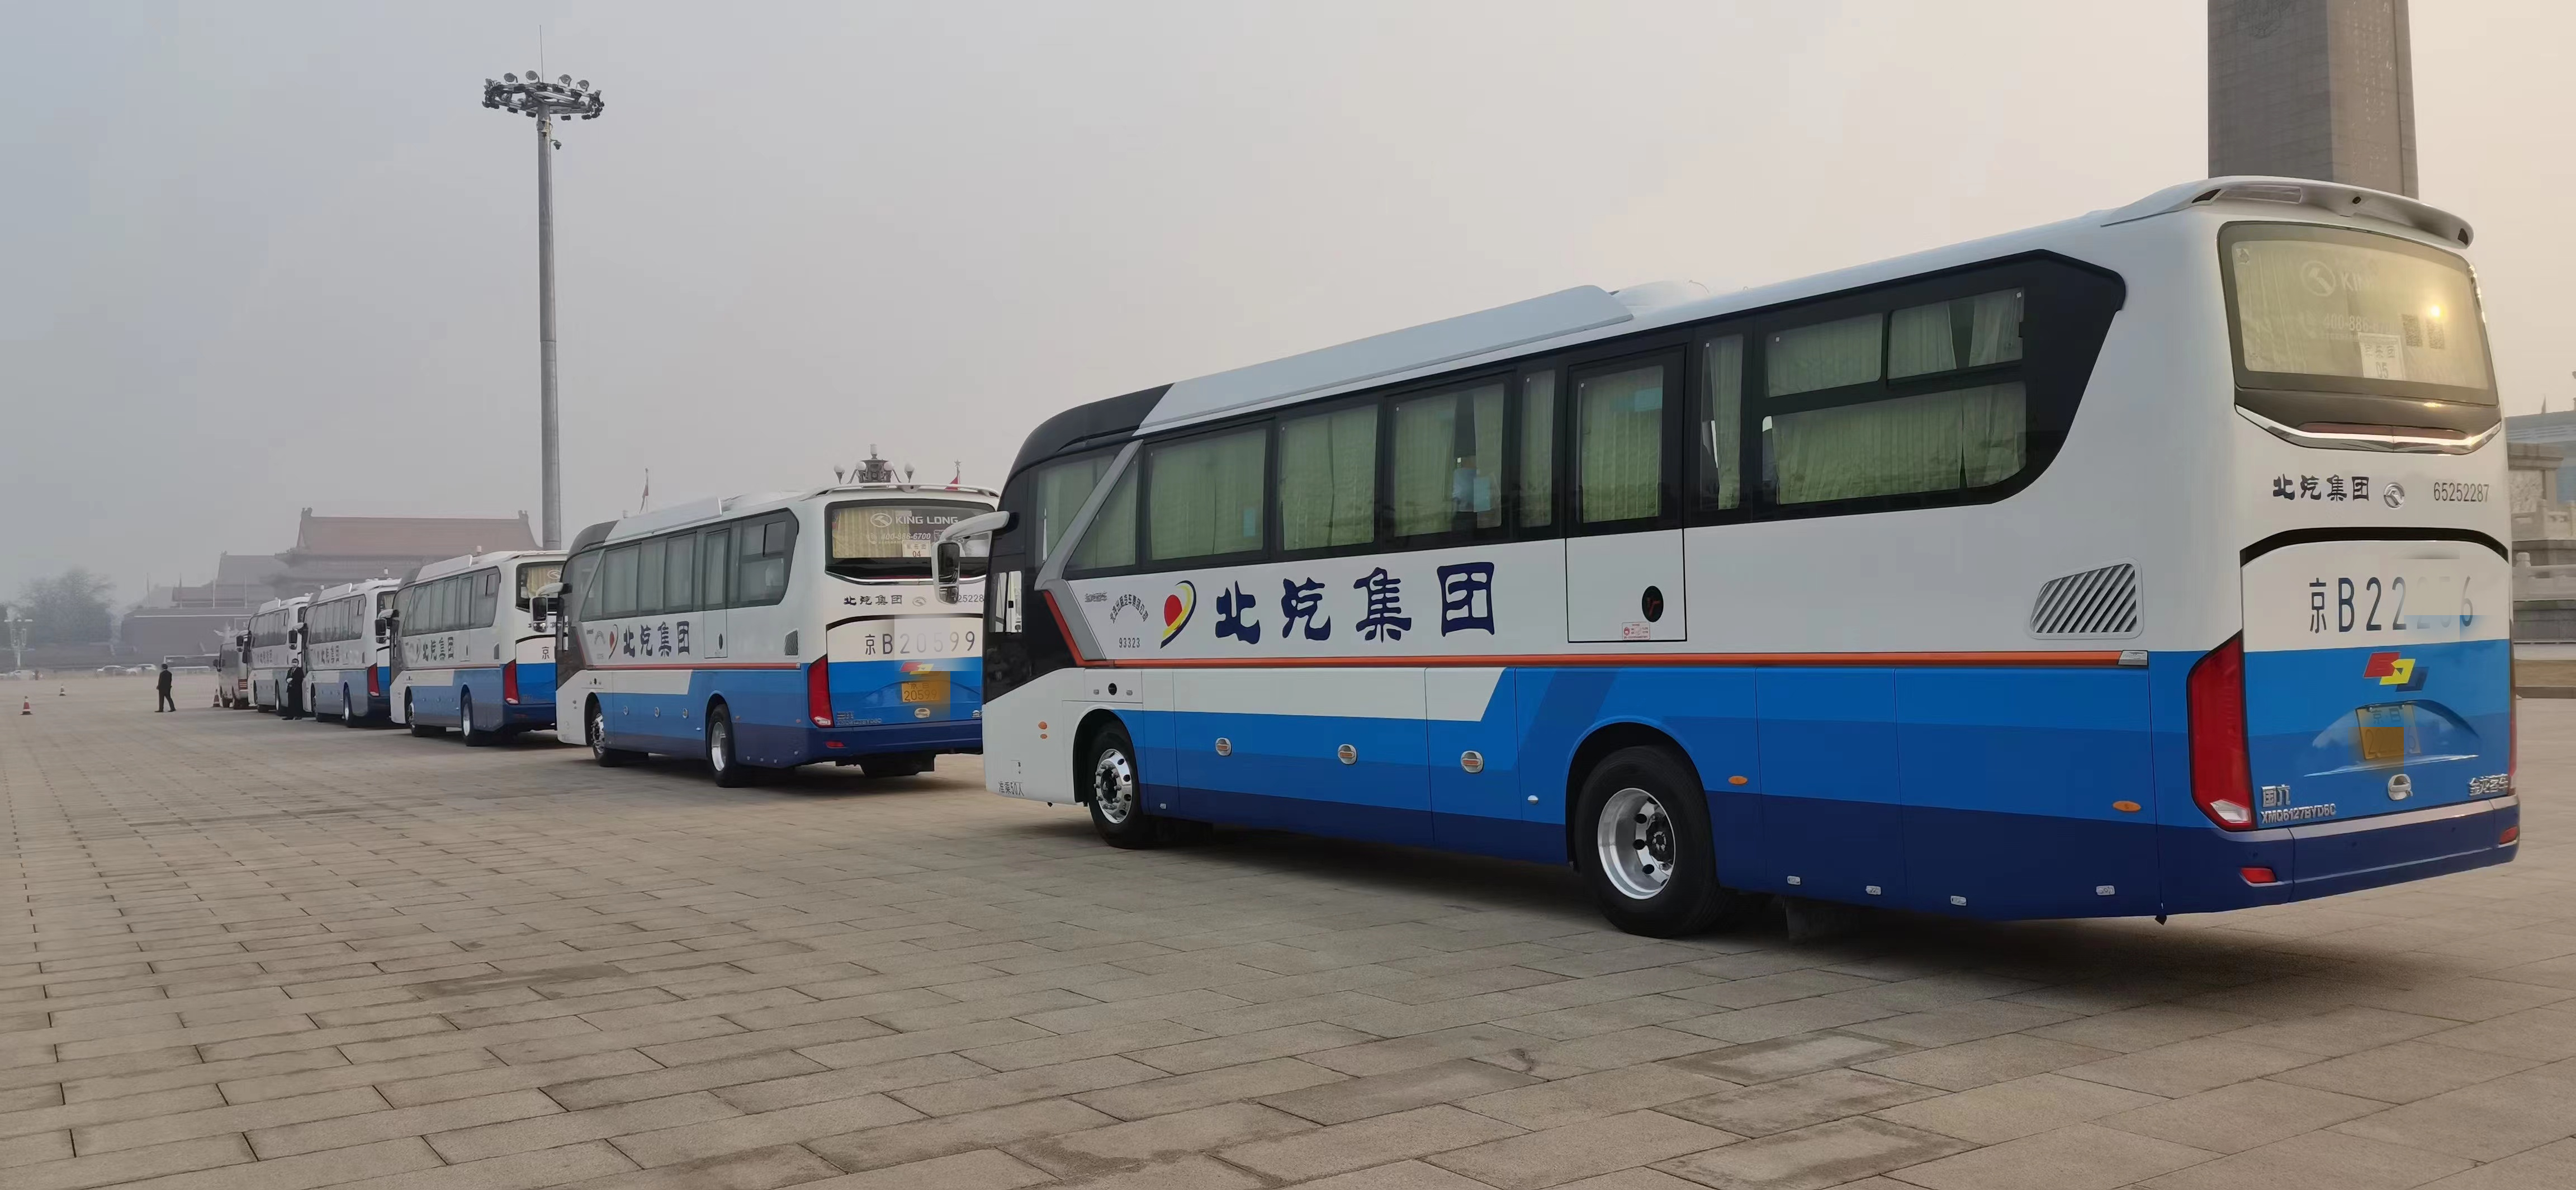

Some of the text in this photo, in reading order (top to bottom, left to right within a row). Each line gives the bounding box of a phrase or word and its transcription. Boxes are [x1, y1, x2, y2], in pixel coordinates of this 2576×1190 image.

[2273, 474, 2370, 502] 北汽集团
[2433, 482, 2490, 503] 65252287
[927, 516, 958, 525] LONG
[843, 594, 903, 606] 北汽集团
[1215, 561, 1495, 644] 北汽集团
[623, 621, 690, 658] 北汽集团
[865, 631, 975, 655] 京B20599
[1119, 638, 1140, 648] 93323
[904, 690, 937, 701] 20599
[2261, 784, 2291, 807] 国六
